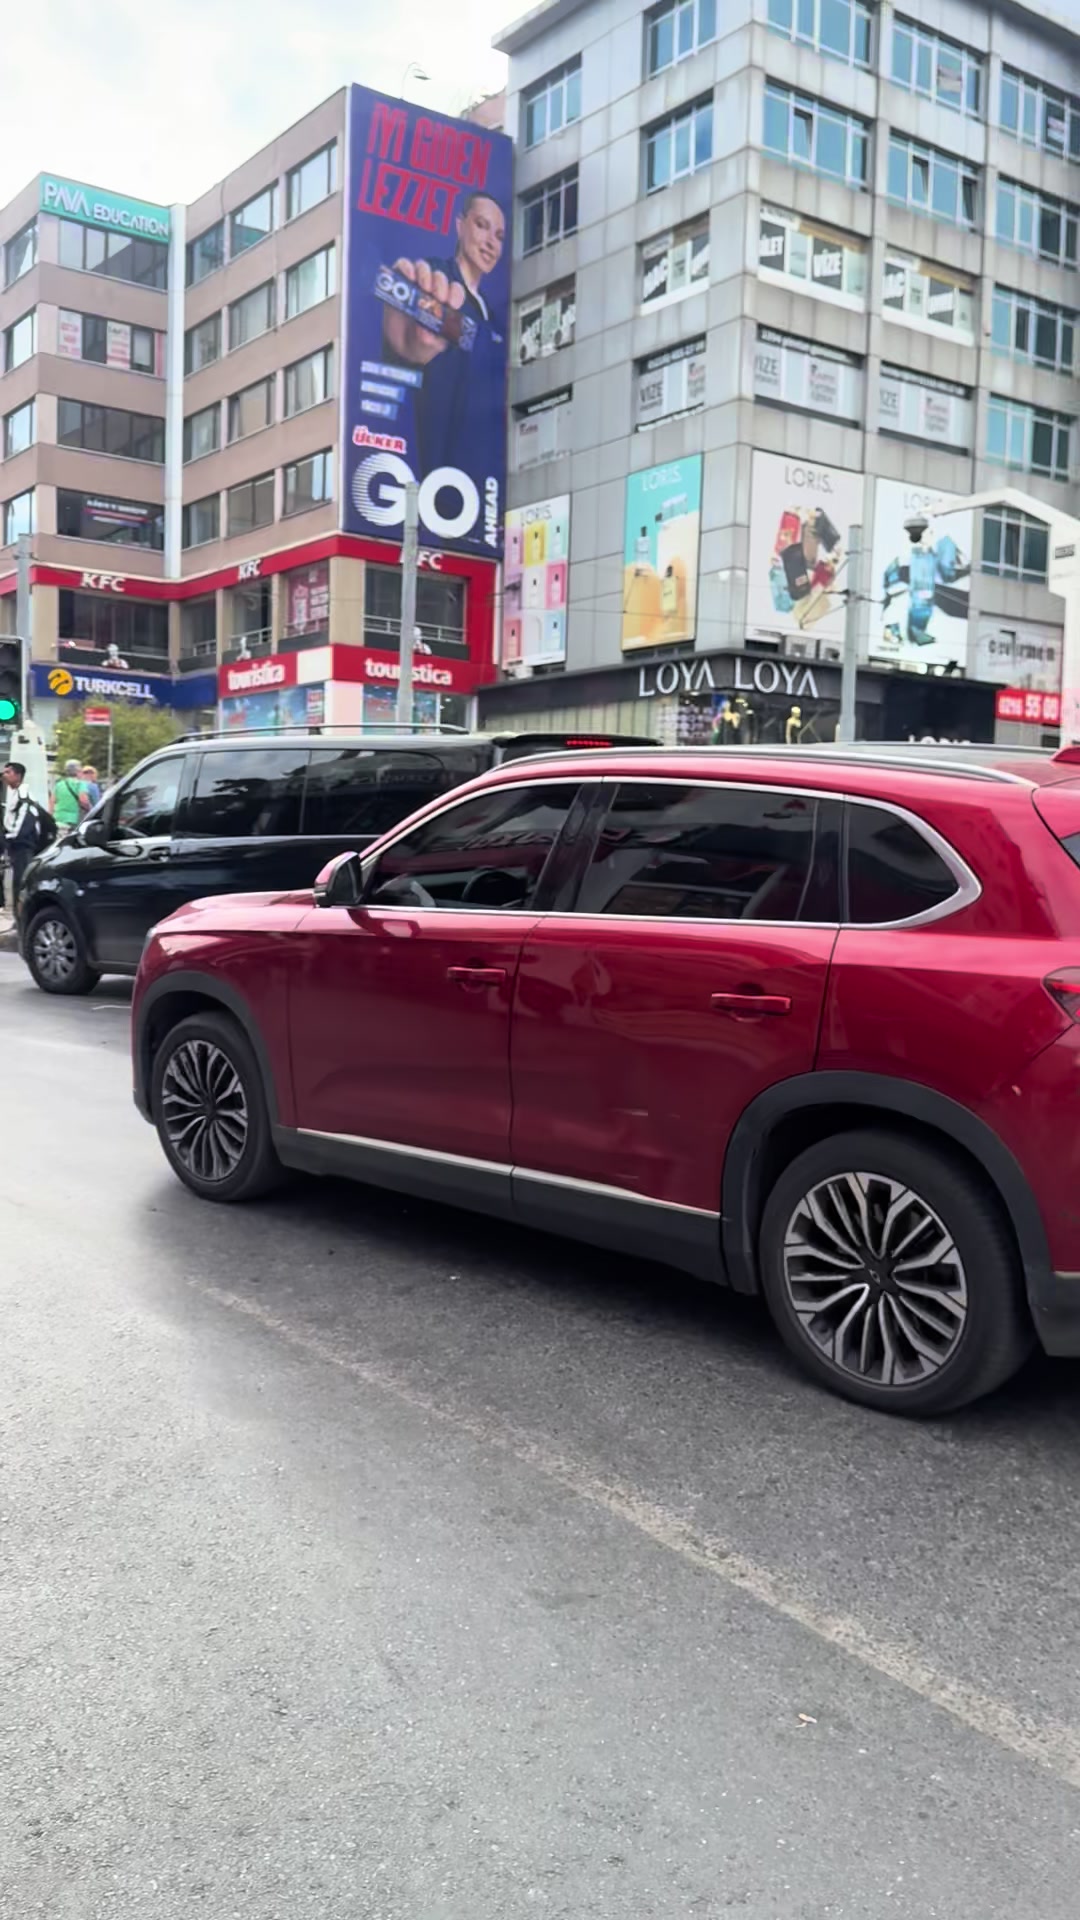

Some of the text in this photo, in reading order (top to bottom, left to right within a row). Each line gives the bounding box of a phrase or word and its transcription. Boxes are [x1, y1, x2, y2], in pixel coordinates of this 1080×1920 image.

[357, 158, 461, 236] LEZZET
[93, 203, 169, 236] EDUCATION
[353, 425, 406, 453] ÜLKER
[352, 452, 480, 540] GO
[81, 572, 126, 593] KFC
[73, 676, 154, 698] TURKCELL
[365, 657, 453, 686] toustica
[638, 658, 715, 697] LOYA
[734, 656, 819, 699] LOYA
